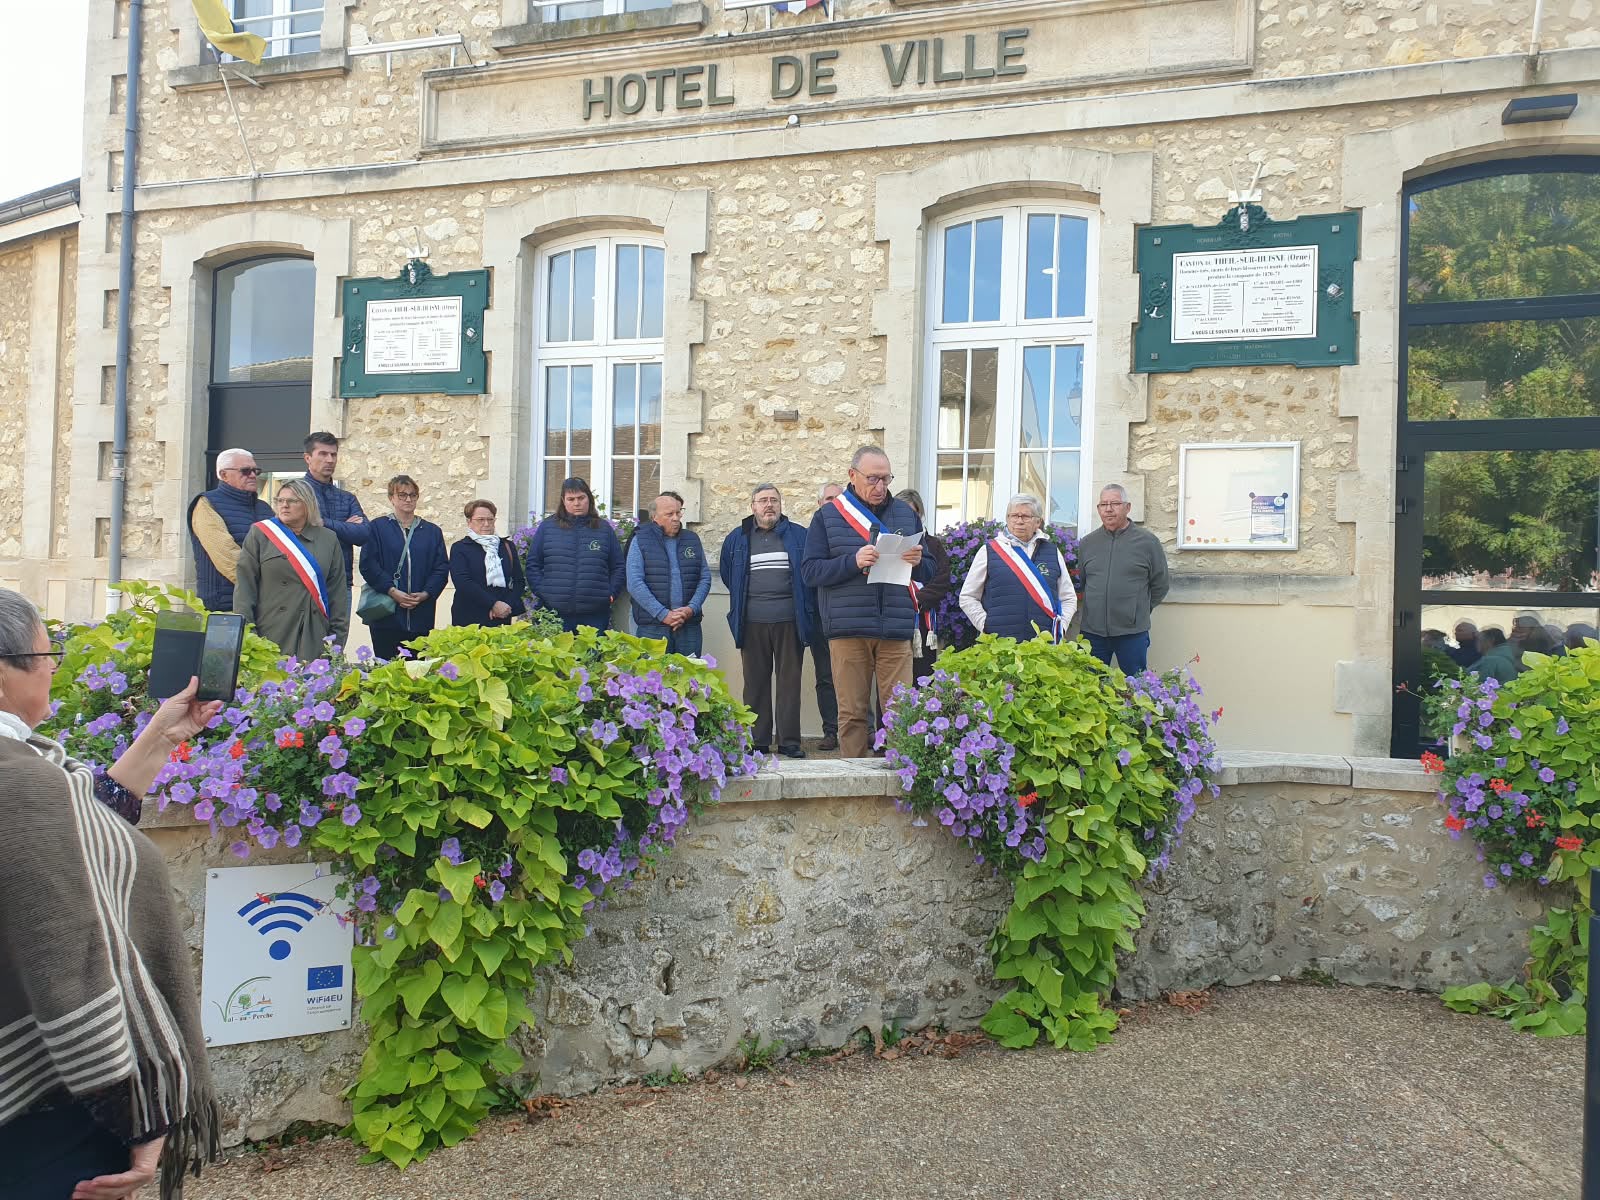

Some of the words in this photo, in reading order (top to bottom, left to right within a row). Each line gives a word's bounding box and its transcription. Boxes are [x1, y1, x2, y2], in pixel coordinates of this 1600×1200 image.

[582, 63, 735, 120] HOTEL
[770, 49, 839, 100] DE
[881, 28, 1029, 88] VILLE
[1287, 253, 1311, 262] (Orne)
[306, 993, 343, 1005] WiFi4EU
[252, 1012, 274, 1021] Perche
